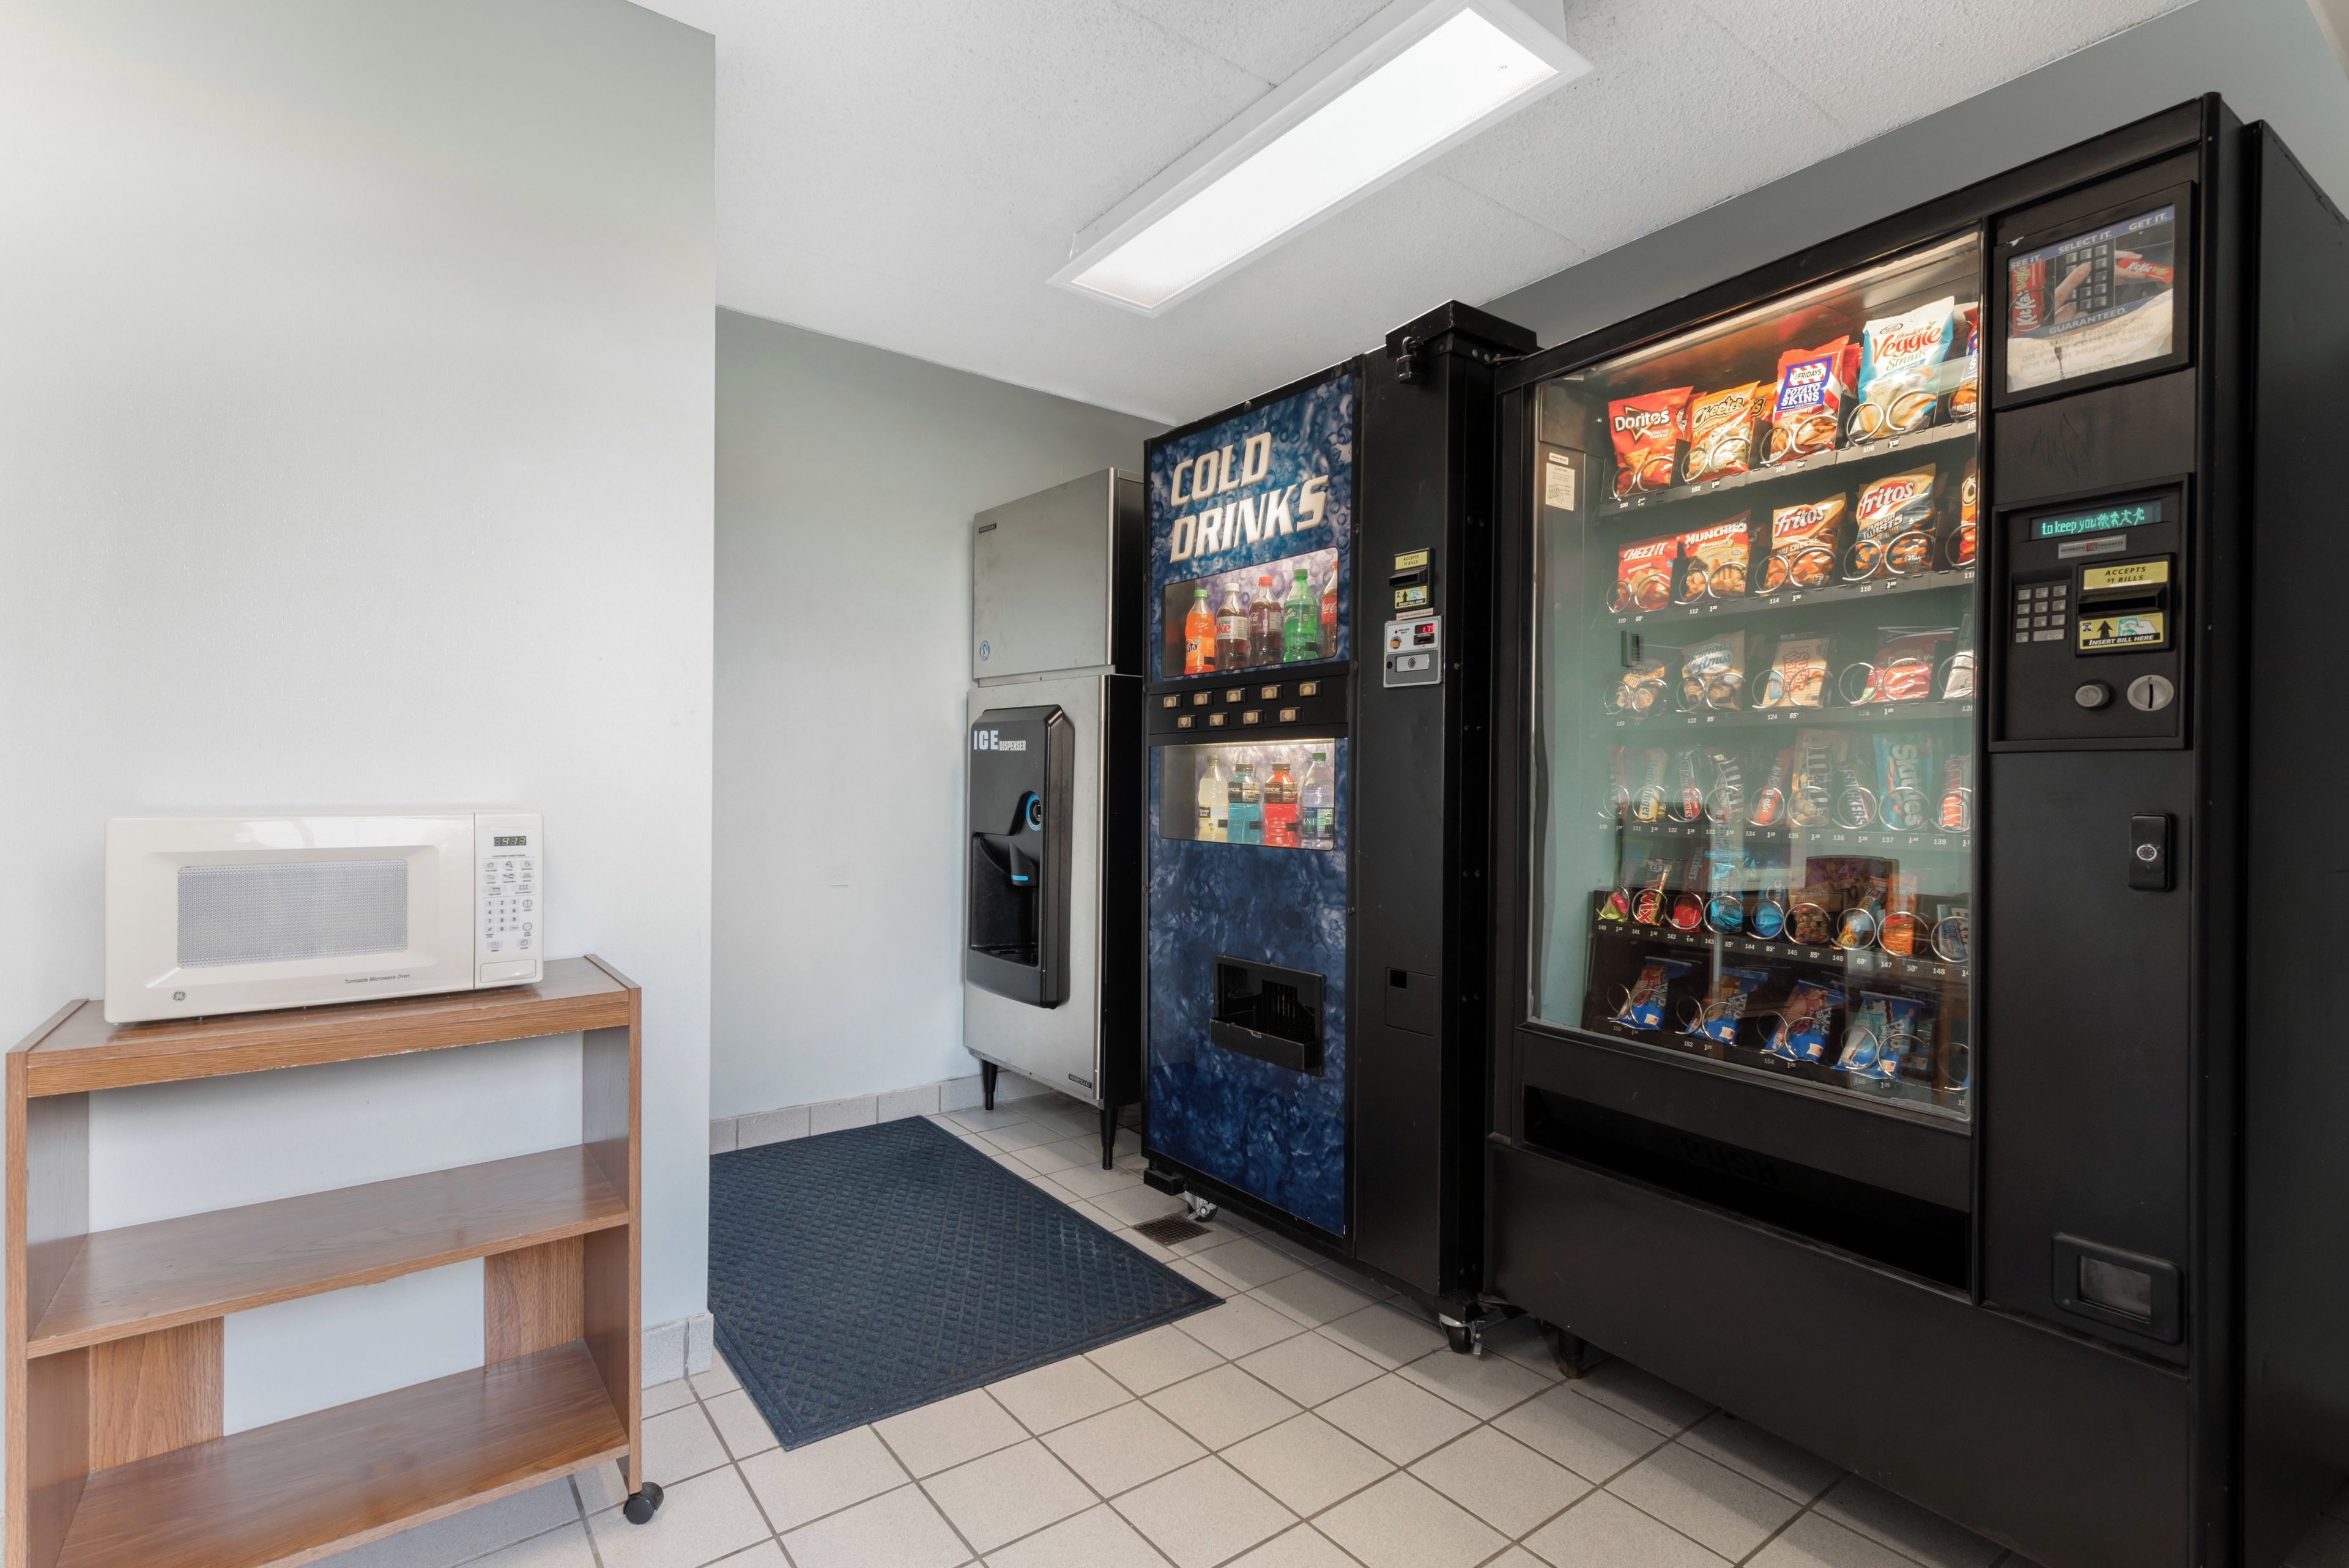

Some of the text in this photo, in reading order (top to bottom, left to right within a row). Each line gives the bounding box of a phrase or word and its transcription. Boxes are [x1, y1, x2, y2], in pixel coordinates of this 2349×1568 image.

[2129, 213, 2167, 231] GET IT.
[2058, 236, 2098, 253] SELECT
[2011, 259, 2028, 269] SEE
[2049, 308, 2127, 334] GUARANTEED.
[1872, 325, 1942, 365] Veggie
[1797, 368, 1822, 379] FRIDAYS
[1781, 392, 1820, 407] SKINS
[1784, 384, 1821, 398] POTATO
[1615, 410, 1670, 431] Doritos
[1693, 396, 1745, 426] Cheetos
[1171, 431, 1272, 507] COLD
[1860, 481, 1914, 519] Fritos
[1170, 475, 1329, 563] DRINKS
[1775, 508, 1825, 538] Fritos
[1861, 513, 1904, 540] TWISTS
[2042, 522, 2053, 535] to
[2055, 521, 2077, 534] keep
[2105, 567, 2146, 576] ACCEPTS
[1218, 623, 1231, 633] ke
[1187, 642, 1198, 653] nta
[2088, 637, 2115, 646] INSERT
[1694, 653, 1733, 674] Amos
[974, 730, 1026, 751] ICE DISPENSER
[1892, 744, 1921, 826] Skittles
[1688, 846, 1704, 881] wizzlers
